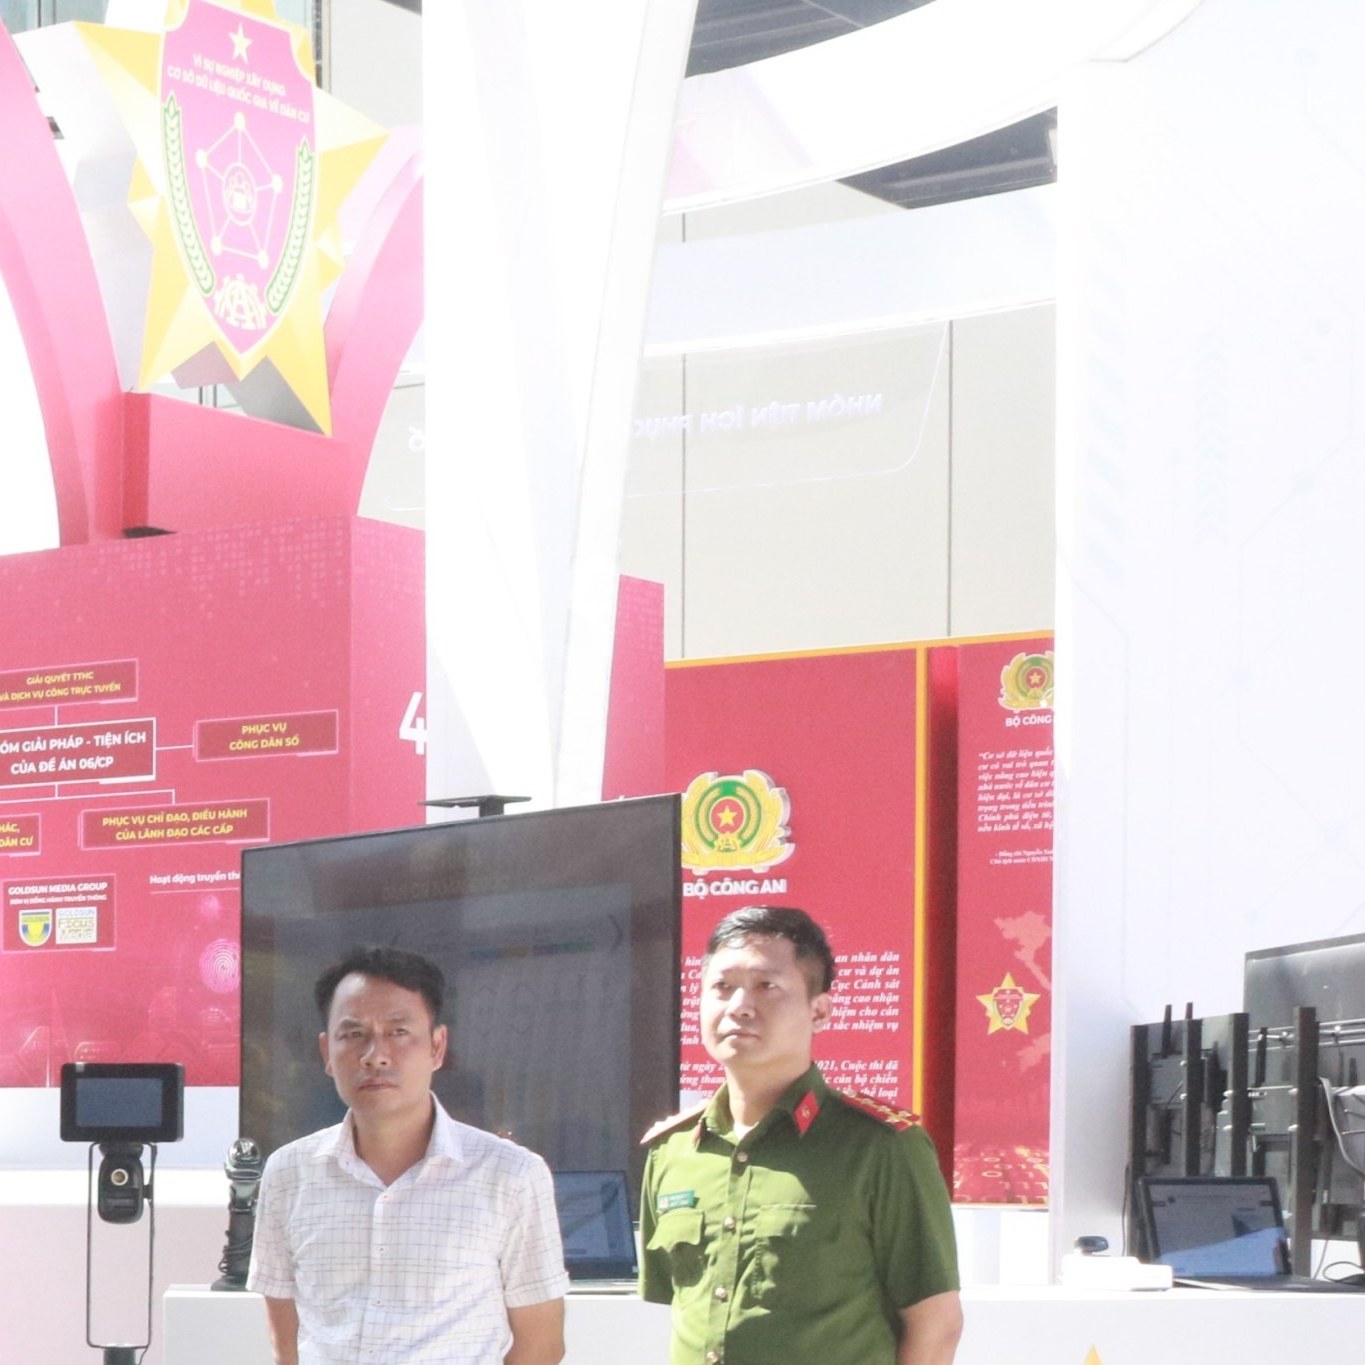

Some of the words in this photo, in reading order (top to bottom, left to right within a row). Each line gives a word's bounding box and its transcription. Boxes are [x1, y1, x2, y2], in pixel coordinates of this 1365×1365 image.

[73, 671, 95, 681] TTHC
[1004, 716, 1021, 728] BỘ
[1022, 714, 1052, 726] CÔNG
[241, 726, 270, 735] PHỤC
[272, 722, 287, 733] VỤ
[21, 737, 47, 752] GIẢI
[49, 734, 84, 750] PHÁP
[94, 730, 122, 748] TIỆN
[124, 729, 147, 744] ÍCH
[229, 739, 259, 750] CÔNG
[260, 737, 283, 749] DÂN
[10, 756, 37, 775] CỦA
[58, 755, 77, 770] ÁN
[79, 756, 115, 770] 06/CP
[102, 815, 130, 827] PHỤC
[131, 814, 145, 826] VỤ
[218, 808, 248, 819] HÀNH
[115, 827, 137, 841] CỦA
[190, 822, 212, 836] CÁC
[150, 875, 171, 885] Hoạt
[172, 872, 196, 885] động
[8, 885, 47, 896] GOLDSUN
[49, 883, 76, 893] MEDIA
[77, 881, 108, 892] GROUP
[683, 878, 707, 900] BỘ
[710, 877, 759, 896] CÔNG
[760, 879, 787, 893] AN
[859, 1006, 878, 1016] cho
